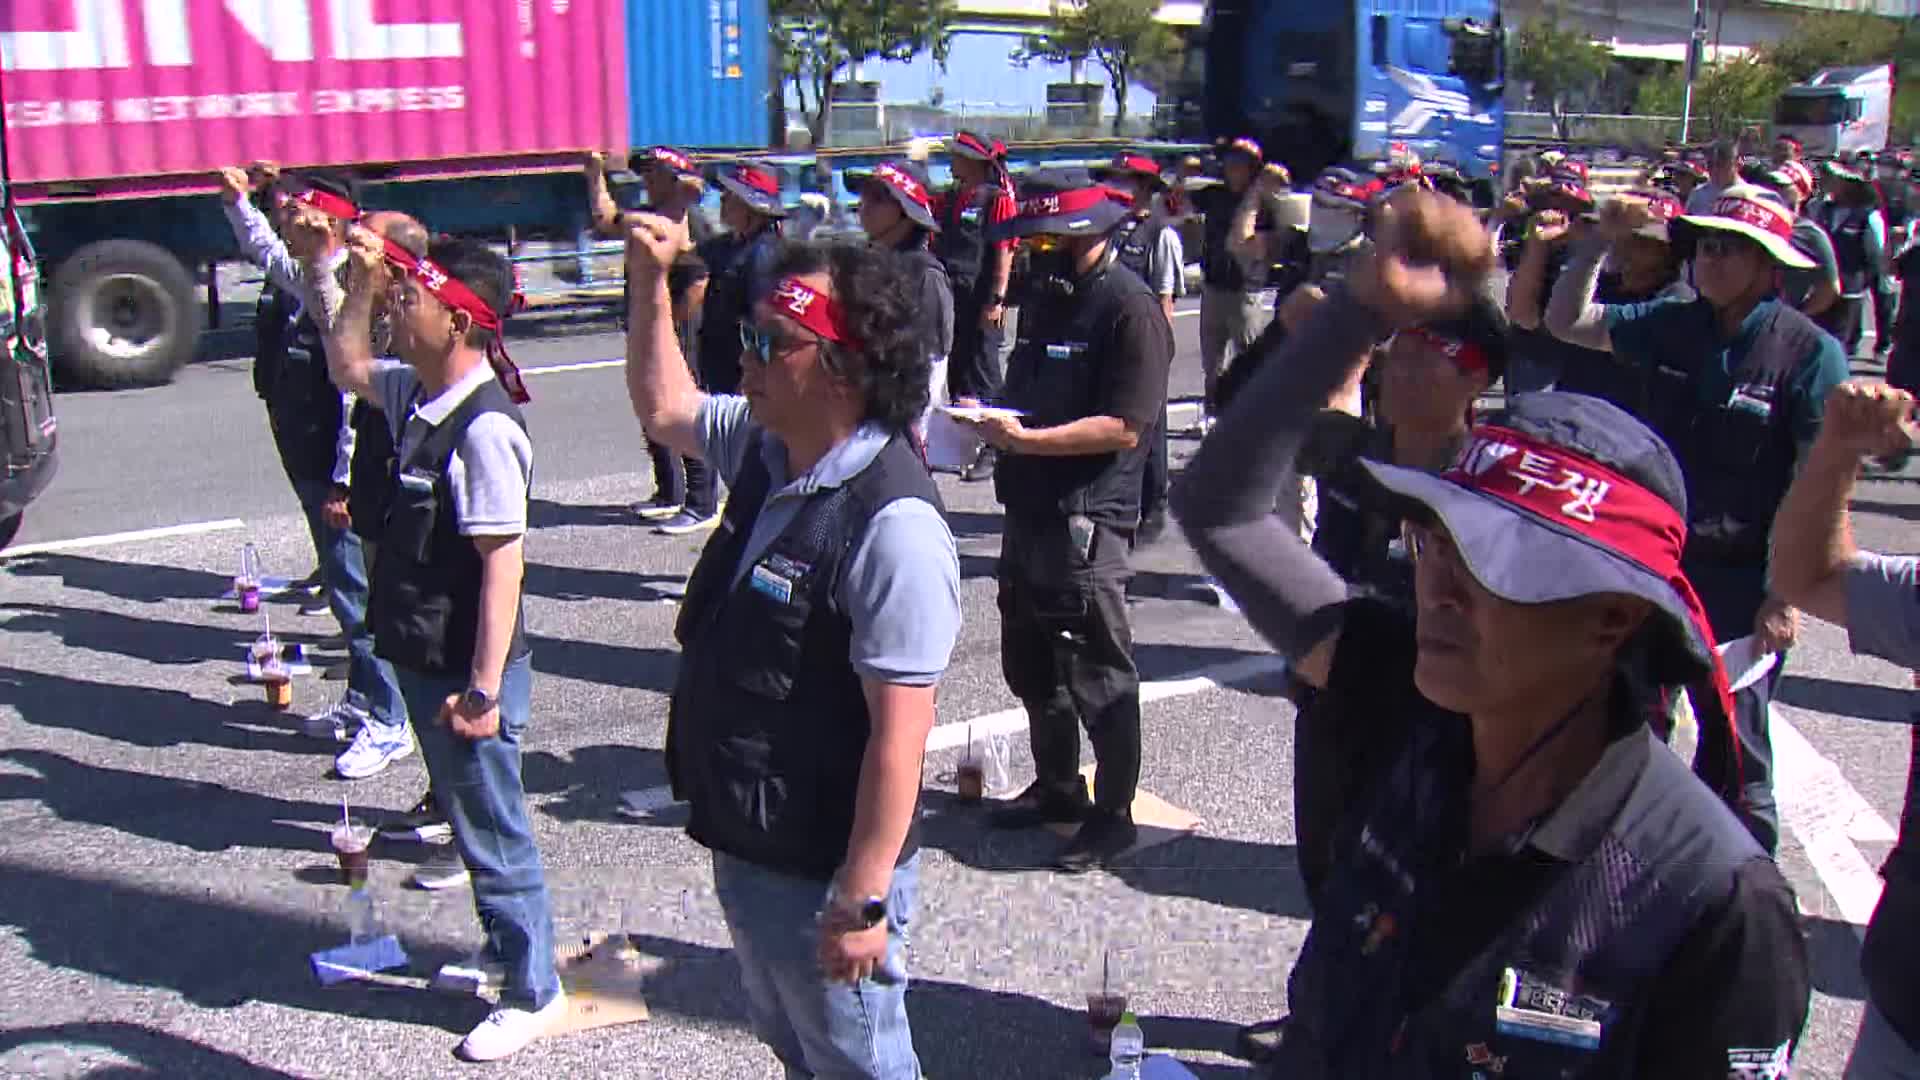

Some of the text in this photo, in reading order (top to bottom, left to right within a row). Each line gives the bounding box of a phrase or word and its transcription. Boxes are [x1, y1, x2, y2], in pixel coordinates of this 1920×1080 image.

[113, 92, 301, 123] NETWORK
[311, 86, 465, 114] EXPRESS
[1507, 449, 1610, 523] 투쟁
